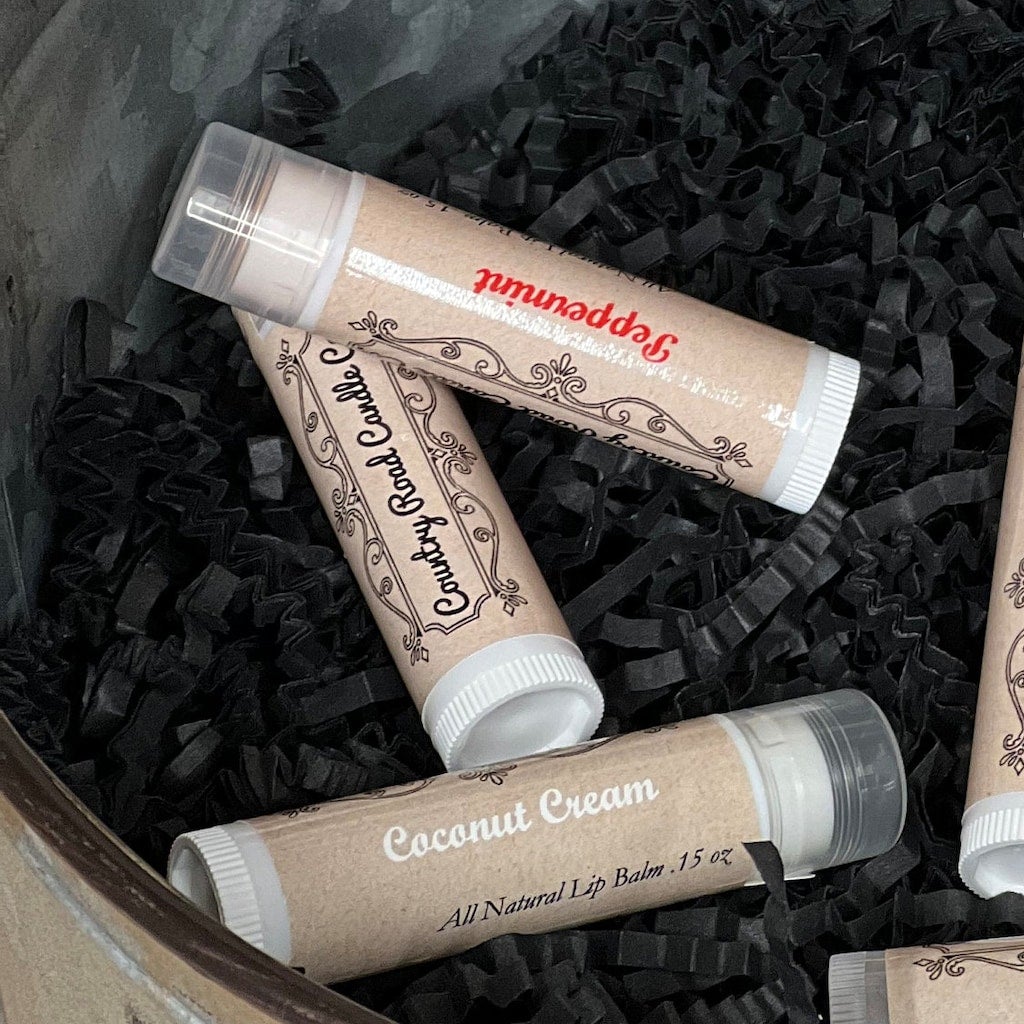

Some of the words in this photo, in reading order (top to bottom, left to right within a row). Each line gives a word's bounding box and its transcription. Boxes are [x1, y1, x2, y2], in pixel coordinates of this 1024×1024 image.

[473, 267, 680, 364] Peppermint
[331, 363, 393, 448] Candle
[364, 446, 426, 517] Road
[409, 514, 471, 617] Country
[383, 801, 533, 862] Coconut
[539, 778, 660, 824] Cream
[436, 904, 477, 933] All
[480, 881, 566, 922] Natural
[568, 874, 606, 900] Lip
[611, 860, 665, 889] Balm
[670, 847, 704, 874] .15
[710, 848, 733, 866] oz
